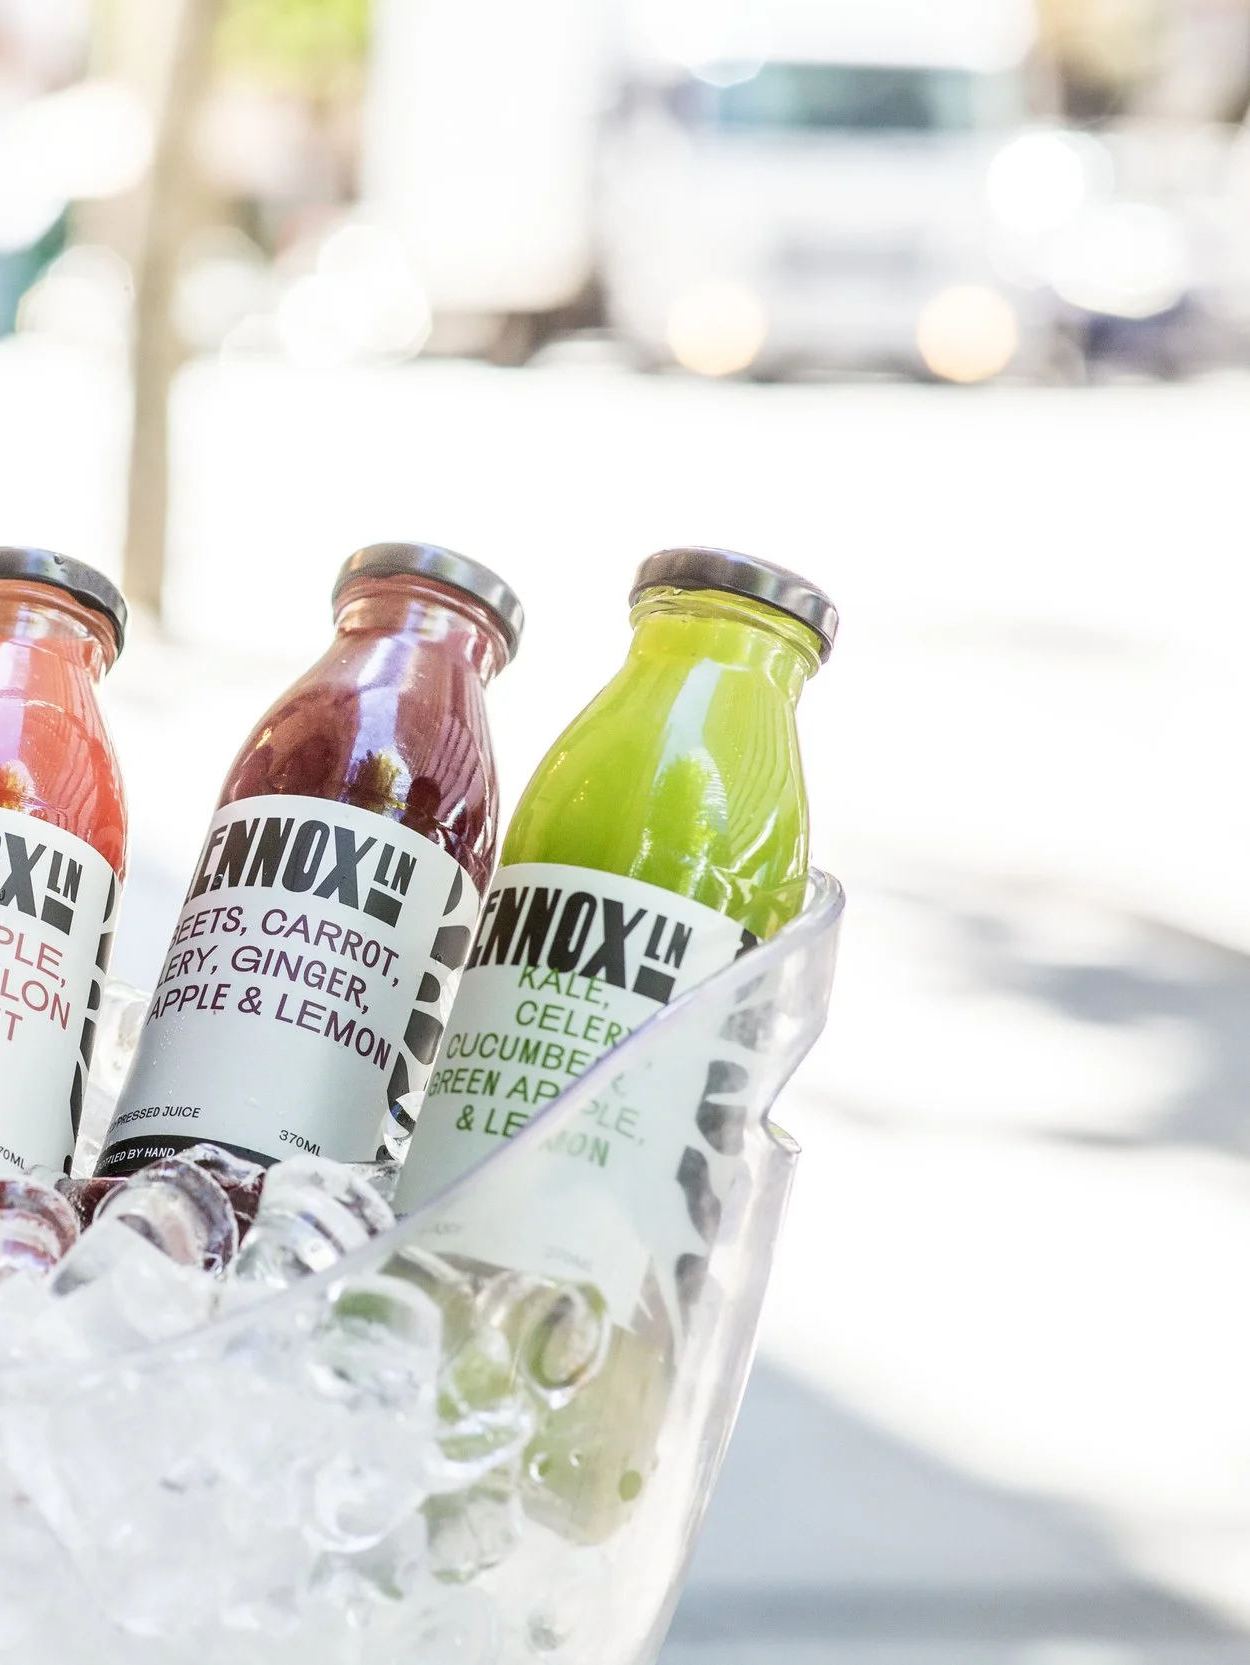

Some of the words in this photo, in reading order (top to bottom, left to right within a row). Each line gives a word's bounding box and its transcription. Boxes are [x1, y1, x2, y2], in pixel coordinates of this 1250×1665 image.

[49, 850, 83, 904] LN
[185, 817, 378, 910] ENNOX
[373, 843, 417, 897] LN
[261, 908, 399, 987] CARROT,
[466, 886, 647, 989] ENNOX
[644, 914, 693, 970] LN
[157, 945, 218, 990] LERY,
[231, 945, 369, 1014] GINGER,
[518, 963, 610, 1010] KALE,
[146, 983, 231, 1027] APPLE
[238, 986, 262, 1016] &
[275, 999, 391, 1071] LEMON
[429, 1067, 501, 1097] GREEN
[117, 1106, 161, 1127] PRESSED
[162, 1106, 201, 1118] JUICE
[456, 1104, 475, 1131] &
[127, 1148, 143, 1160] BY
[279, 1129, 320, 1157] 370ML
